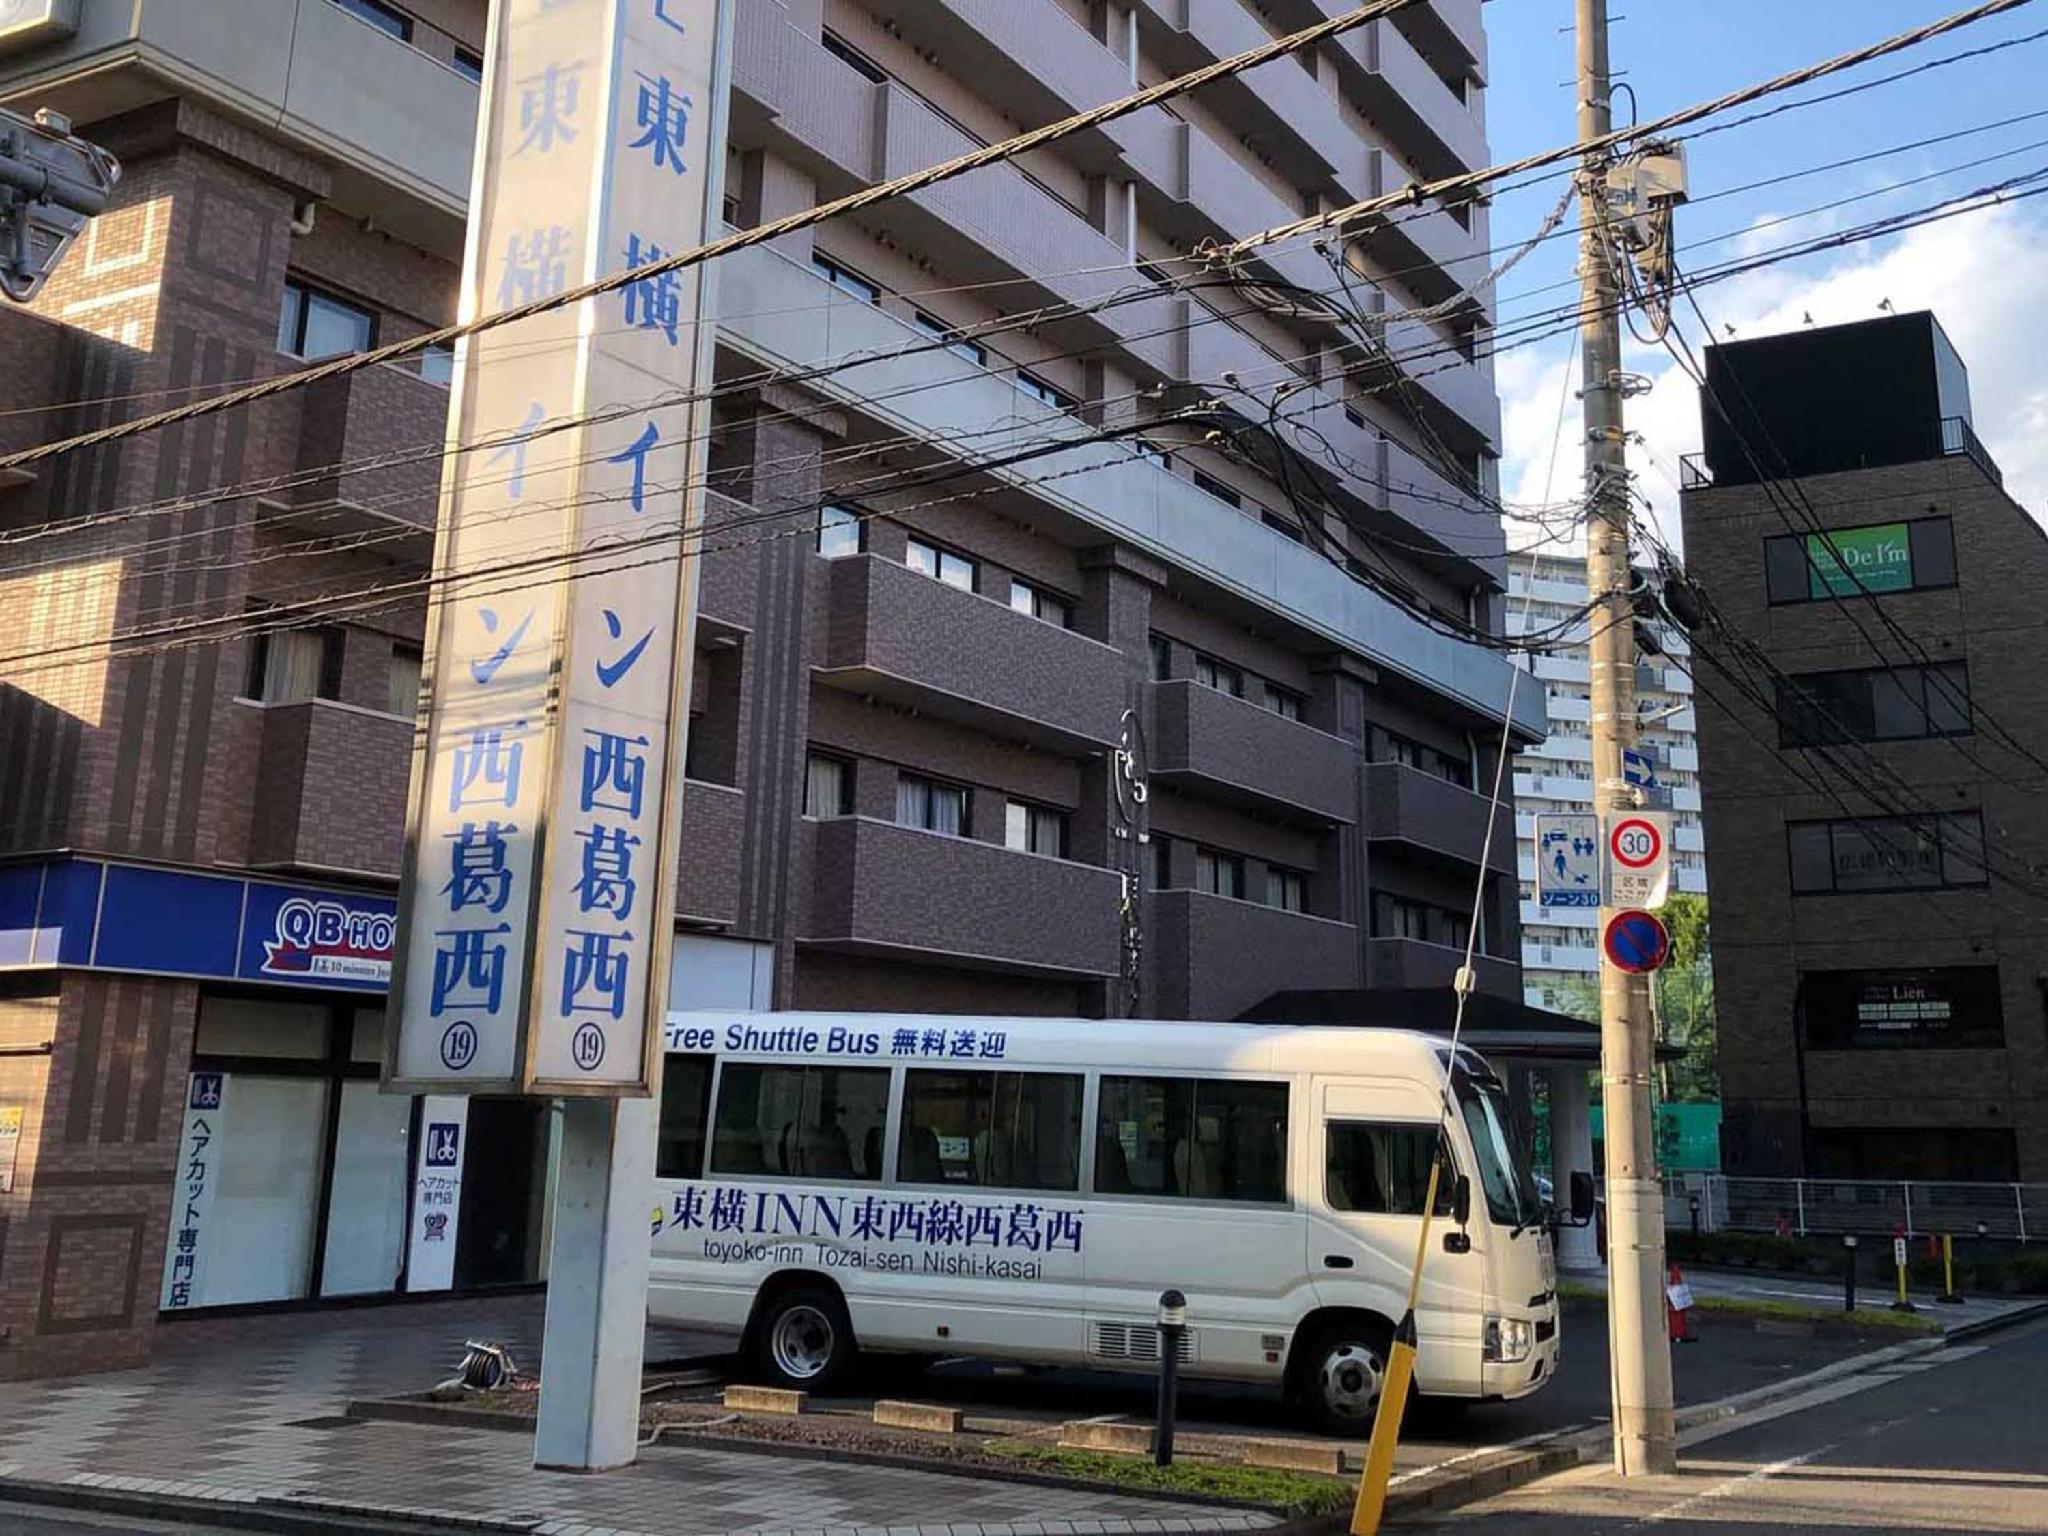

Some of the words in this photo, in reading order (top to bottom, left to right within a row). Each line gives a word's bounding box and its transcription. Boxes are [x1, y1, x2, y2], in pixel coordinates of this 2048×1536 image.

[561, 75, 692, 1019] 東横イン西葛西
[1621, 833, 1651, 854] 30
[1543, 893, 1598, 906] ゾーン30
[277, 899, 347, 949] QB
[348, 911, 397, 951] HO
[1893, 985, 1925, 999] Lien
[725, 1024, 818, 1053] Shuttle
[827, 1027, 880, 1055] Bus
[891, 1028, 1007, 1059] 無料送迎
[168, 1117, 211, 1308] ヘアカット専門店
[704, 1238, 803, 1265] toyoko-inn
[815, 1243, 914, 1273] Tozai-sen
[924, 1250, 1042, 1280] Nishi-kasai
